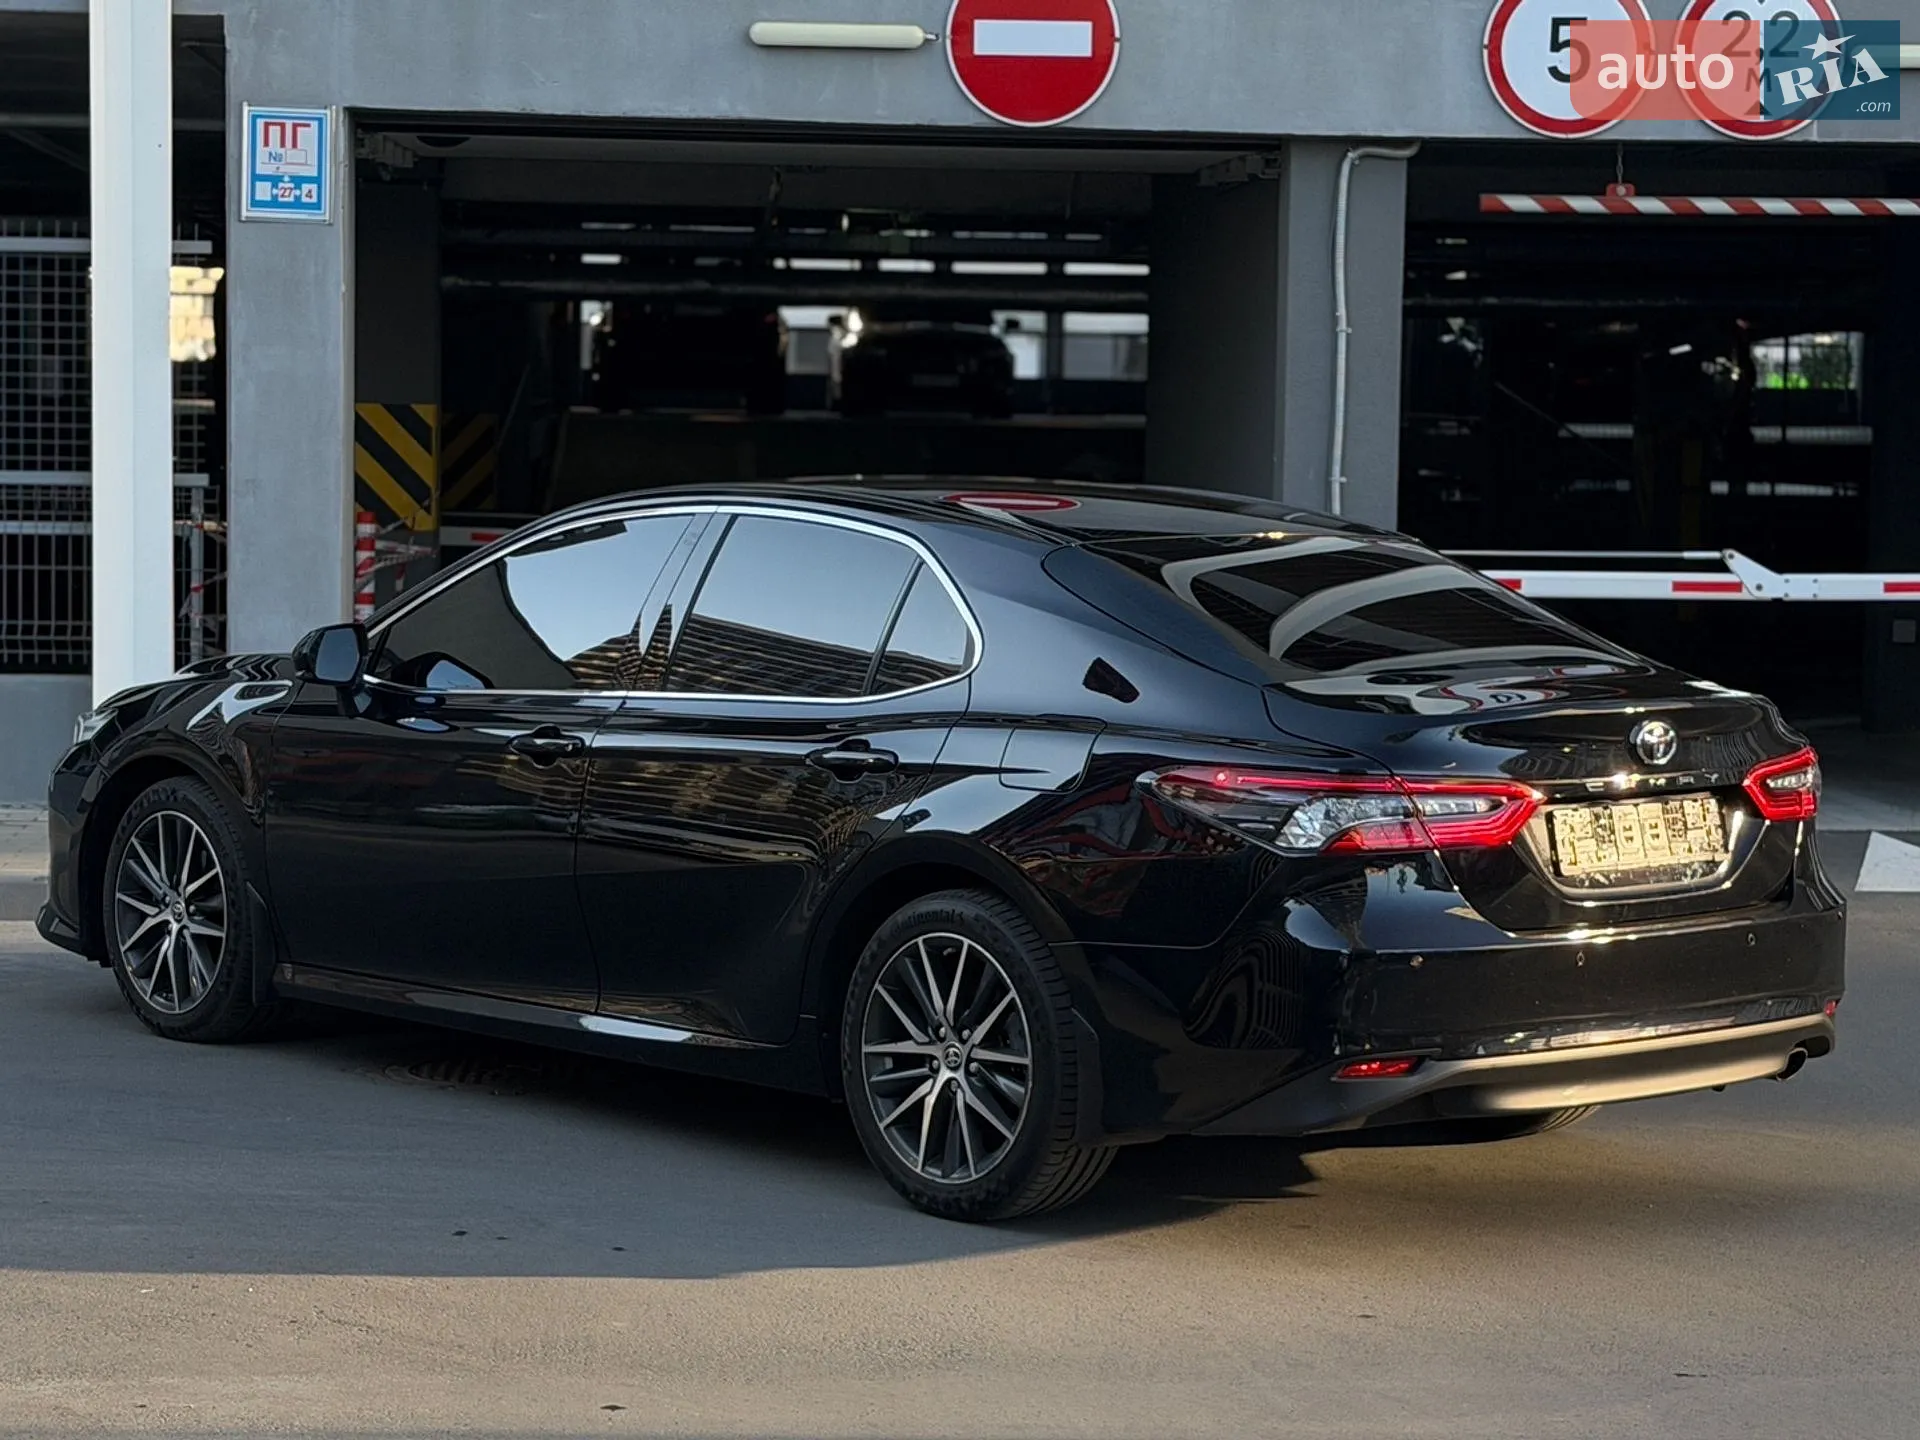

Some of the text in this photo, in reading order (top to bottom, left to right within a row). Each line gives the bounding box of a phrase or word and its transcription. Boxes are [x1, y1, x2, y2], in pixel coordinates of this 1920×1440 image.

[1547, 17, 1591, 83] 5
[263, 121, 312, 149] ПГ
[280, 187, 314, 200] 27 4
